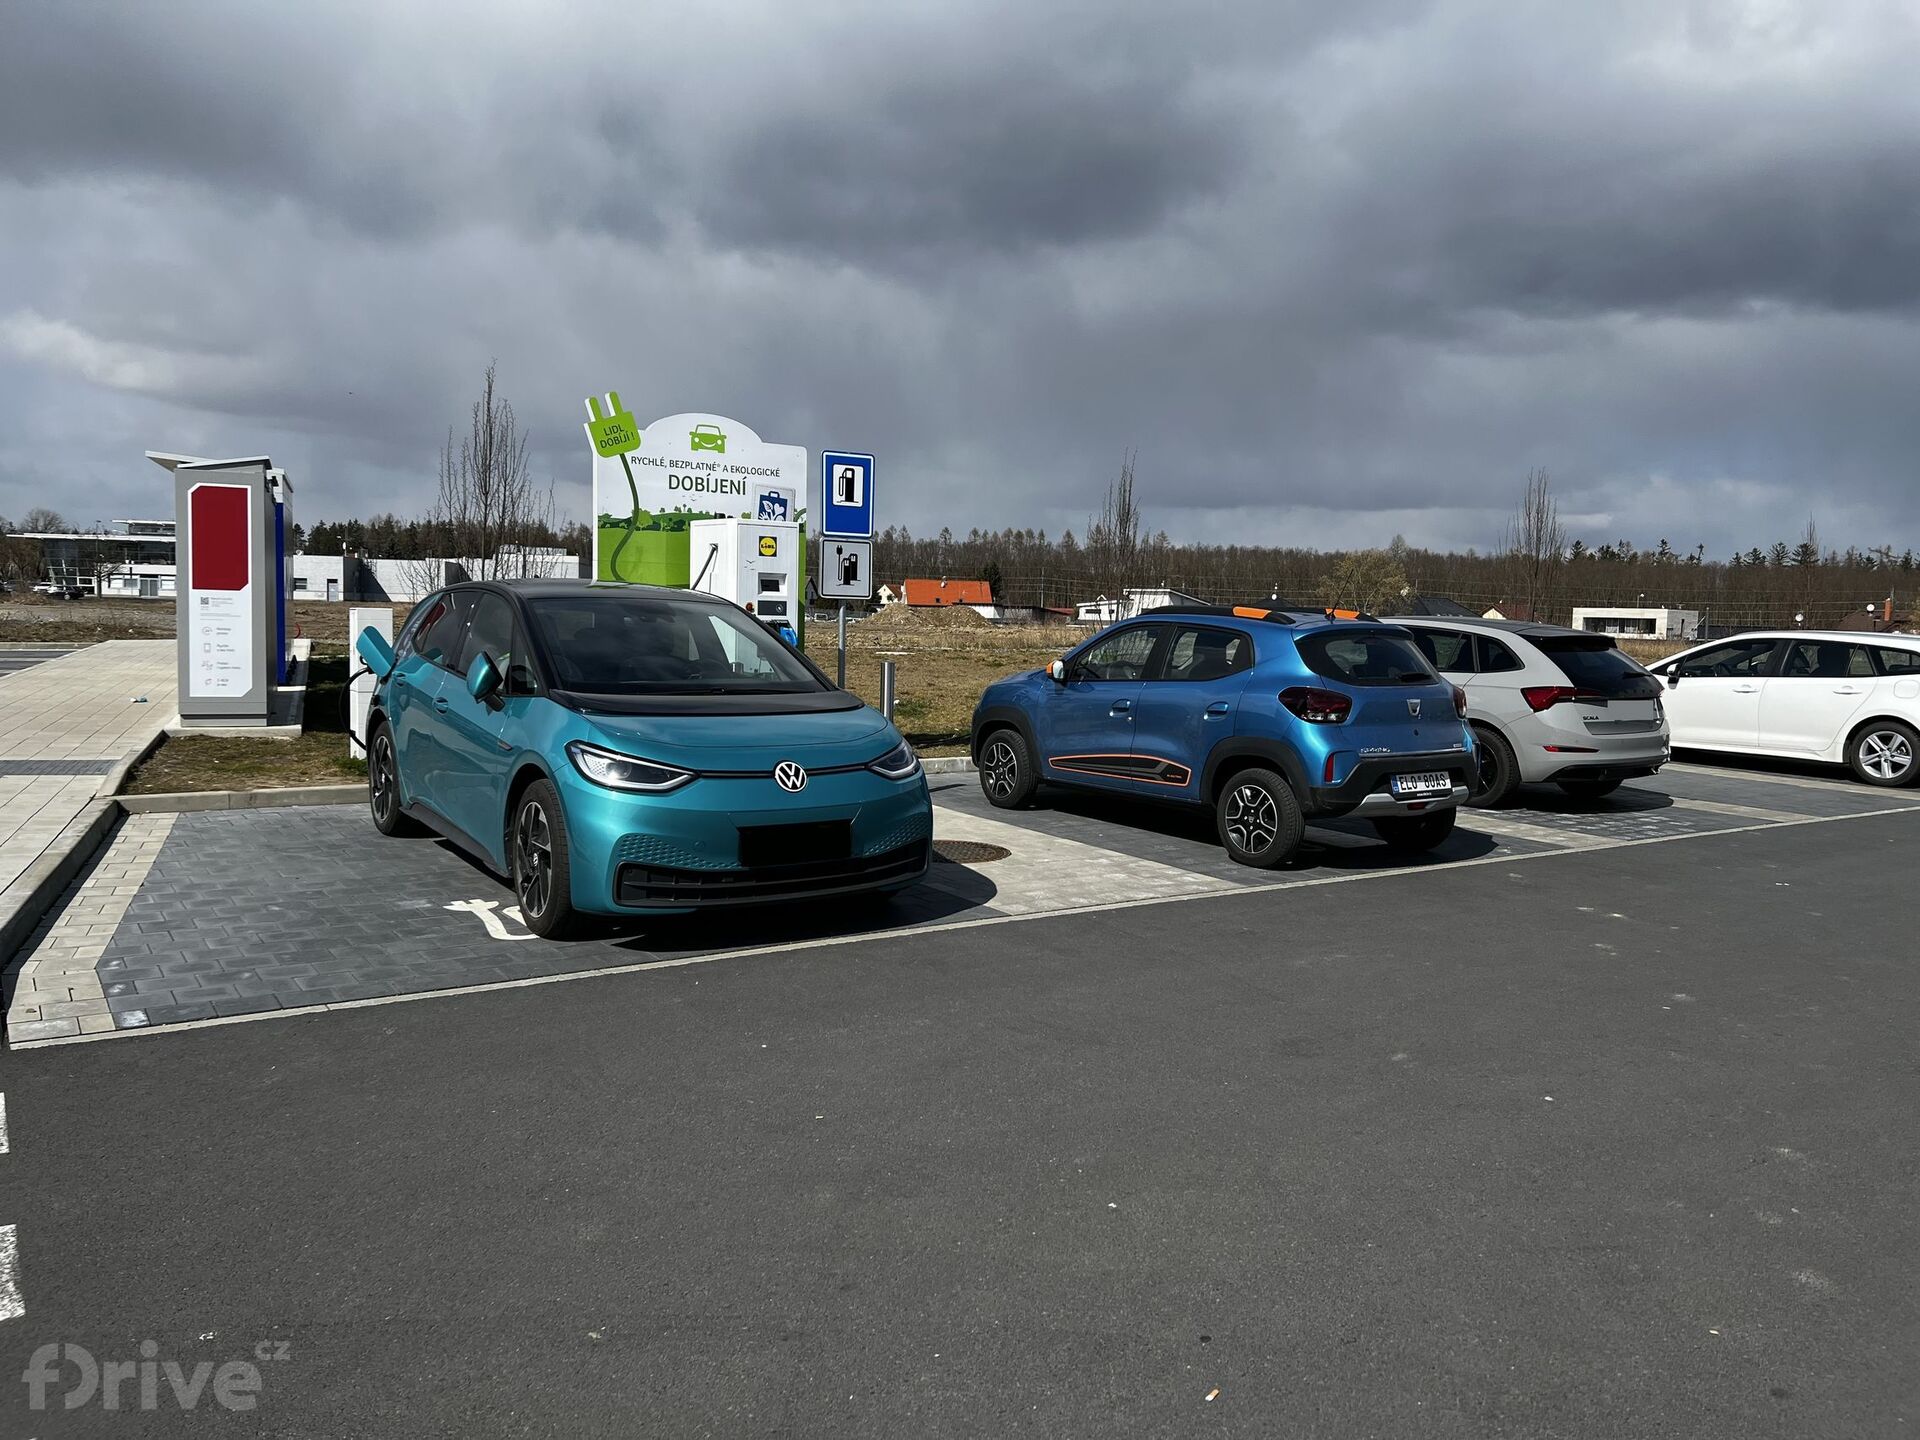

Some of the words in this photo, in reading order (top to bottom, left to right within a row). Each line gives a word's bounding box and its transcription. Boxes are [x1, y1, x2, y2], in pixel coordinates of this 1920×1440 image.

[603, 424, 625, 436] LIDL
[631, 456, 667, 468] RYCHLÉ,
[730, 465, 781, 477] EKOLOGICKÉ
[668, 473, 747, 496] DOBÍJENÍ
